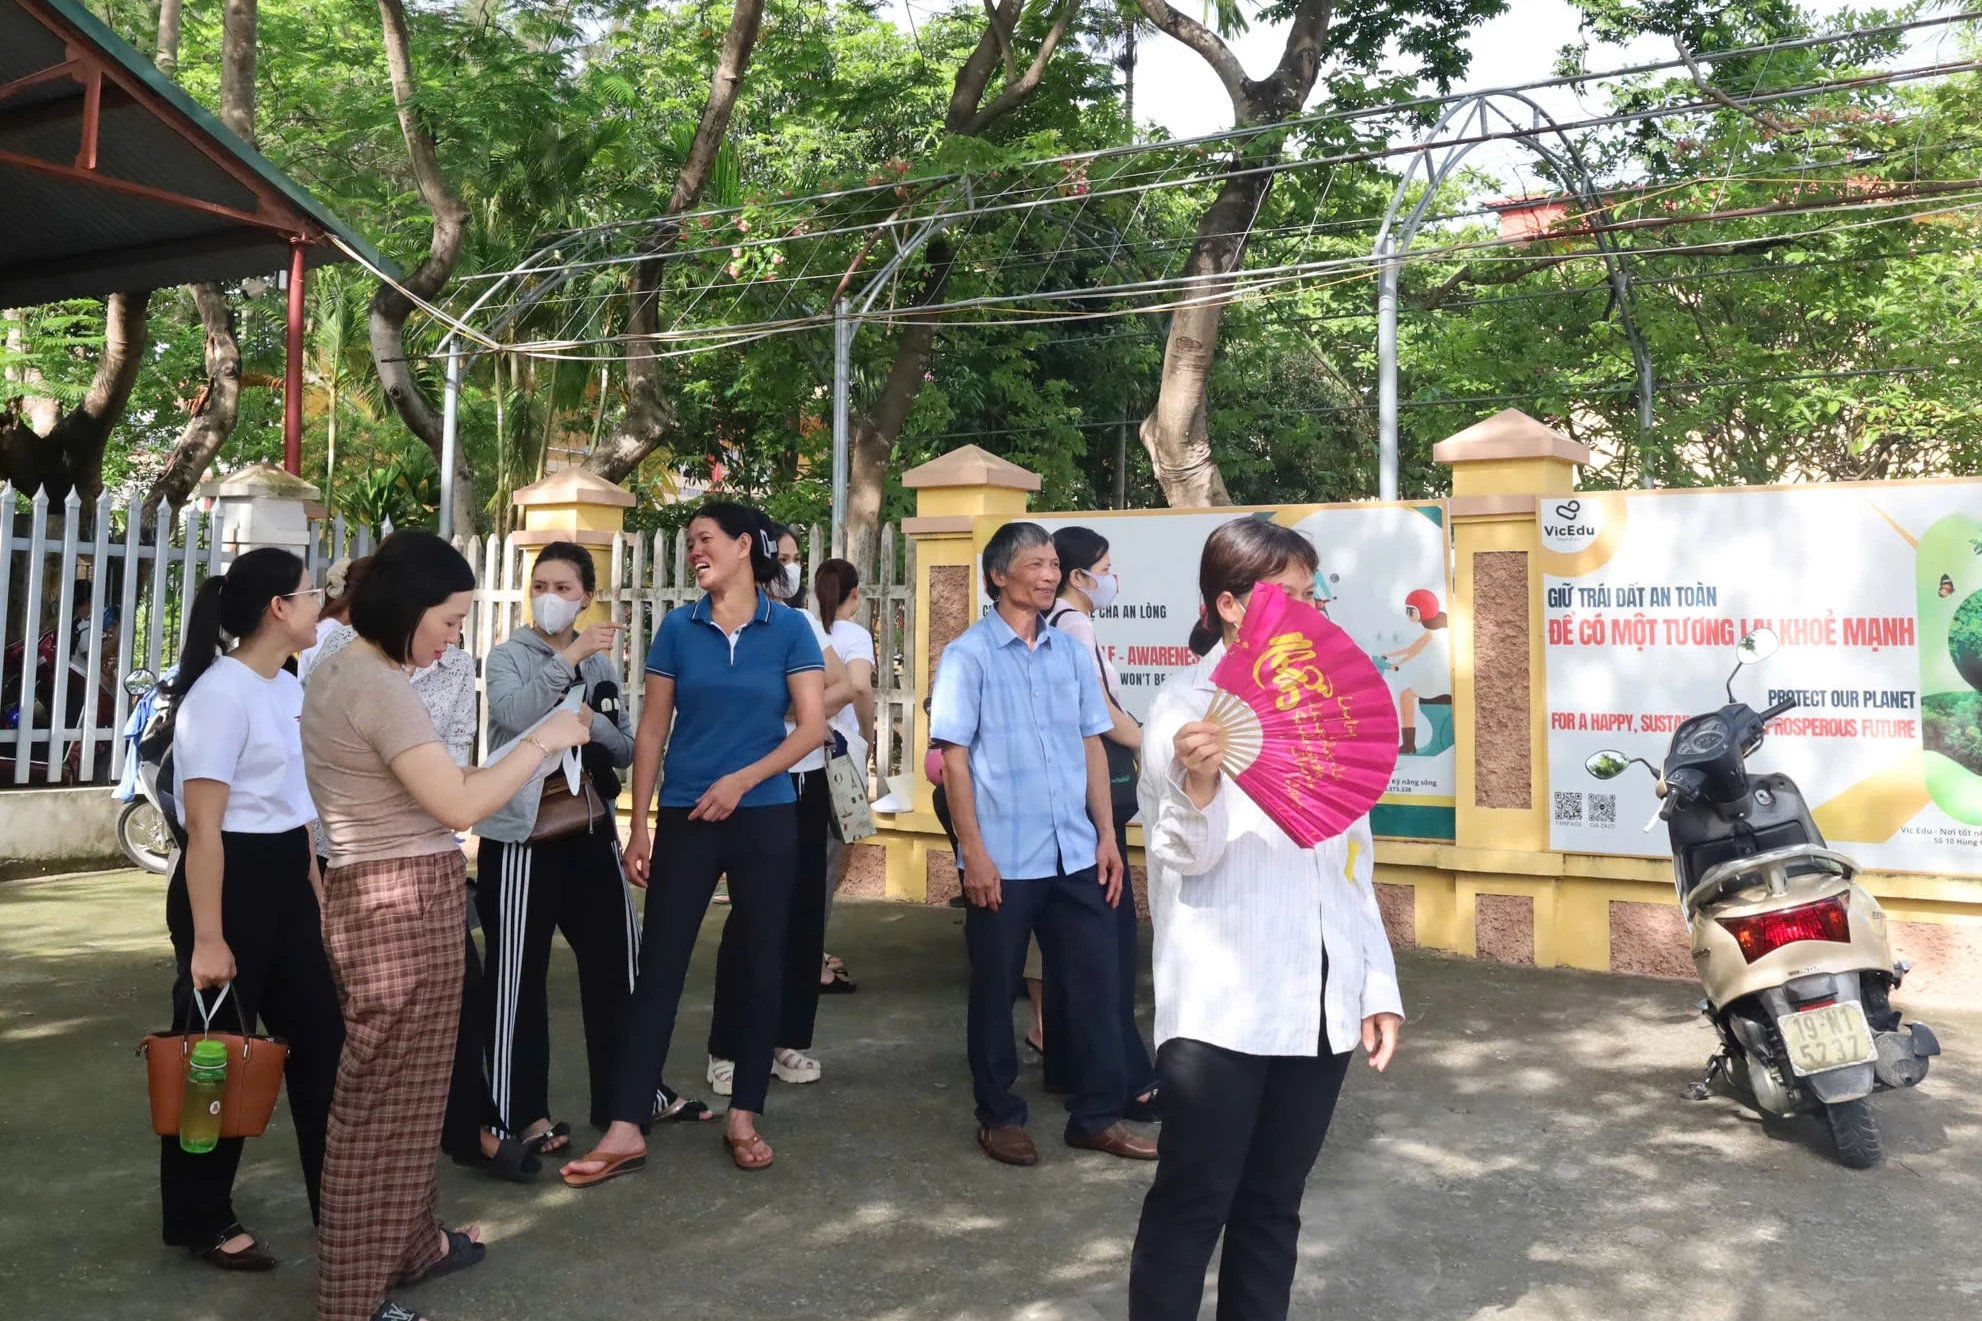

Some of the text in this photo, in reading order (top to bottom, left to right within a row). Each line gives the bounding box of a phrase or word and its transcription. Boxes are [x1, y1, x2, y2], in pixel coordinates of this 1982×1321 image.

[1544, 525, 1595, 536] VicEdu
[1548, 582, 1717, 608] GIỮ TRÁI ĐẤT AN TOÀN
[1099, 605, 1119, 618] CHA
[1123, 605, 1136, 618] AN
[1140, 602, 1167, 618] LÒNG
[1548, 612, 1576, 645] ĐỂ
[1579, 613, 1606, 645] CÓ
[1611, 612, 1657, 651] MỘT
[1663, 617, 1734, 645] TƯƠNG
[1779, 609, 1836, 646] KHOẺ
[1843, 617, 1914, 652] MẠNH
[1120, 673, 1150, 685] WON'T
[1831, 691, 1859, 708] OUR
[1863, 691, 1916, 709] PLANET
[1551, 712, 1575, 730] FOR
[1579, 714, 1588, 731] A
[1591, 713, 1638, 734] HAPPY,
[1862, 719, 1917, 739] FUTURE
